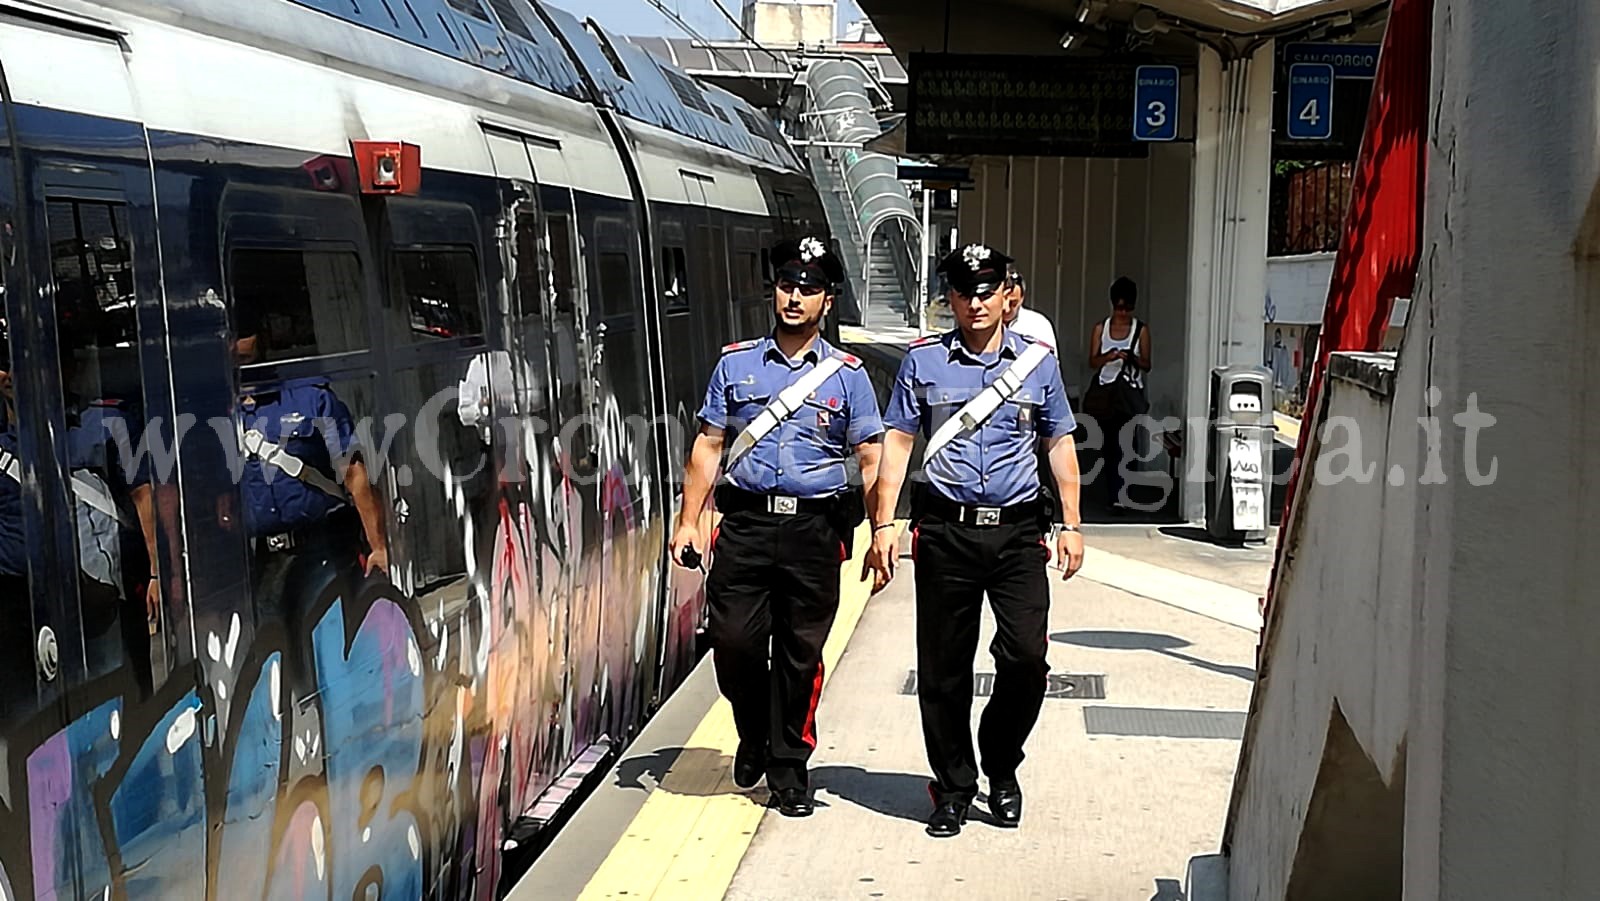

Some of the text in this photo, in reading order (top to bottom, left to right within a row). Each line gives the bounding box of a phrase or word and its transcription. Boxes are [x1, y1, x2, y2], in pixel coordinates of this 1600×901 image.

[1321, 54, 1374, 67] GIORGIO
[1292, 76, 1330, 85] BINARIO
[1145, 101, 1166, 128] 3
[1299, 98, 1321, 126] 4
